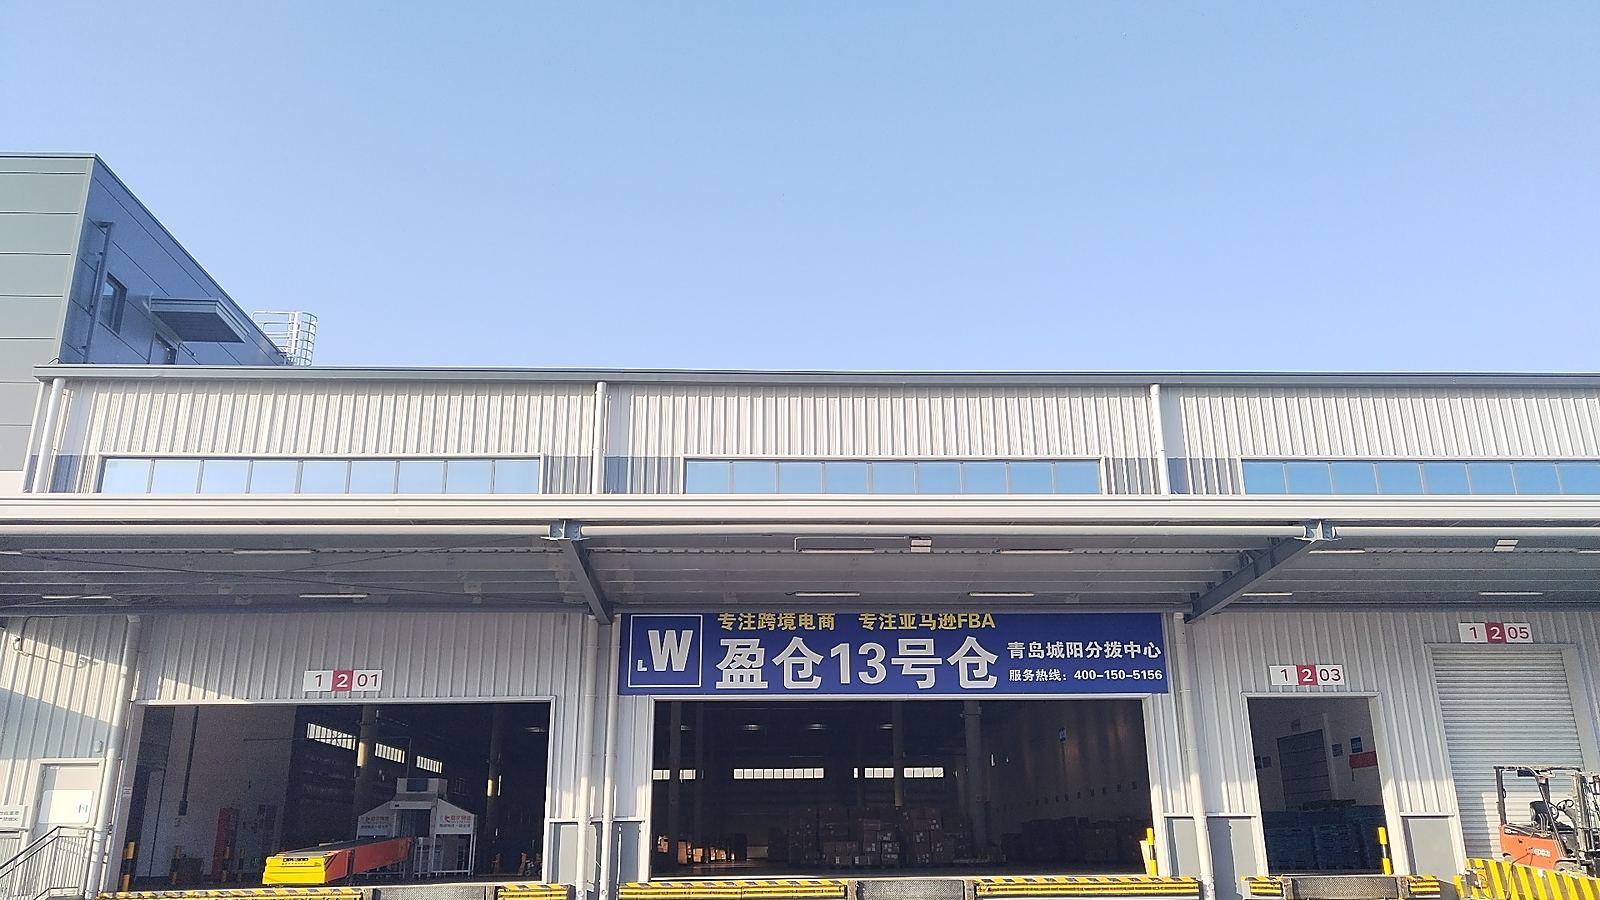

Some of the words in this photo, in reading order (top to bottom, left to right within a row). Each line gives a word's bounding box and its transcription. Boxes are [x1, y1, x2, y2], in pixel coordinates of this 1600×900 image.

[717, 612, 836, 631] 专注跨境电商
[858, 612, 996, 631] 专注亚马逊FBA
[1007, 641, 1162, 659] 青岛城阳分拨中心
[715, 636, 999, 690] 盈仓13号仓
